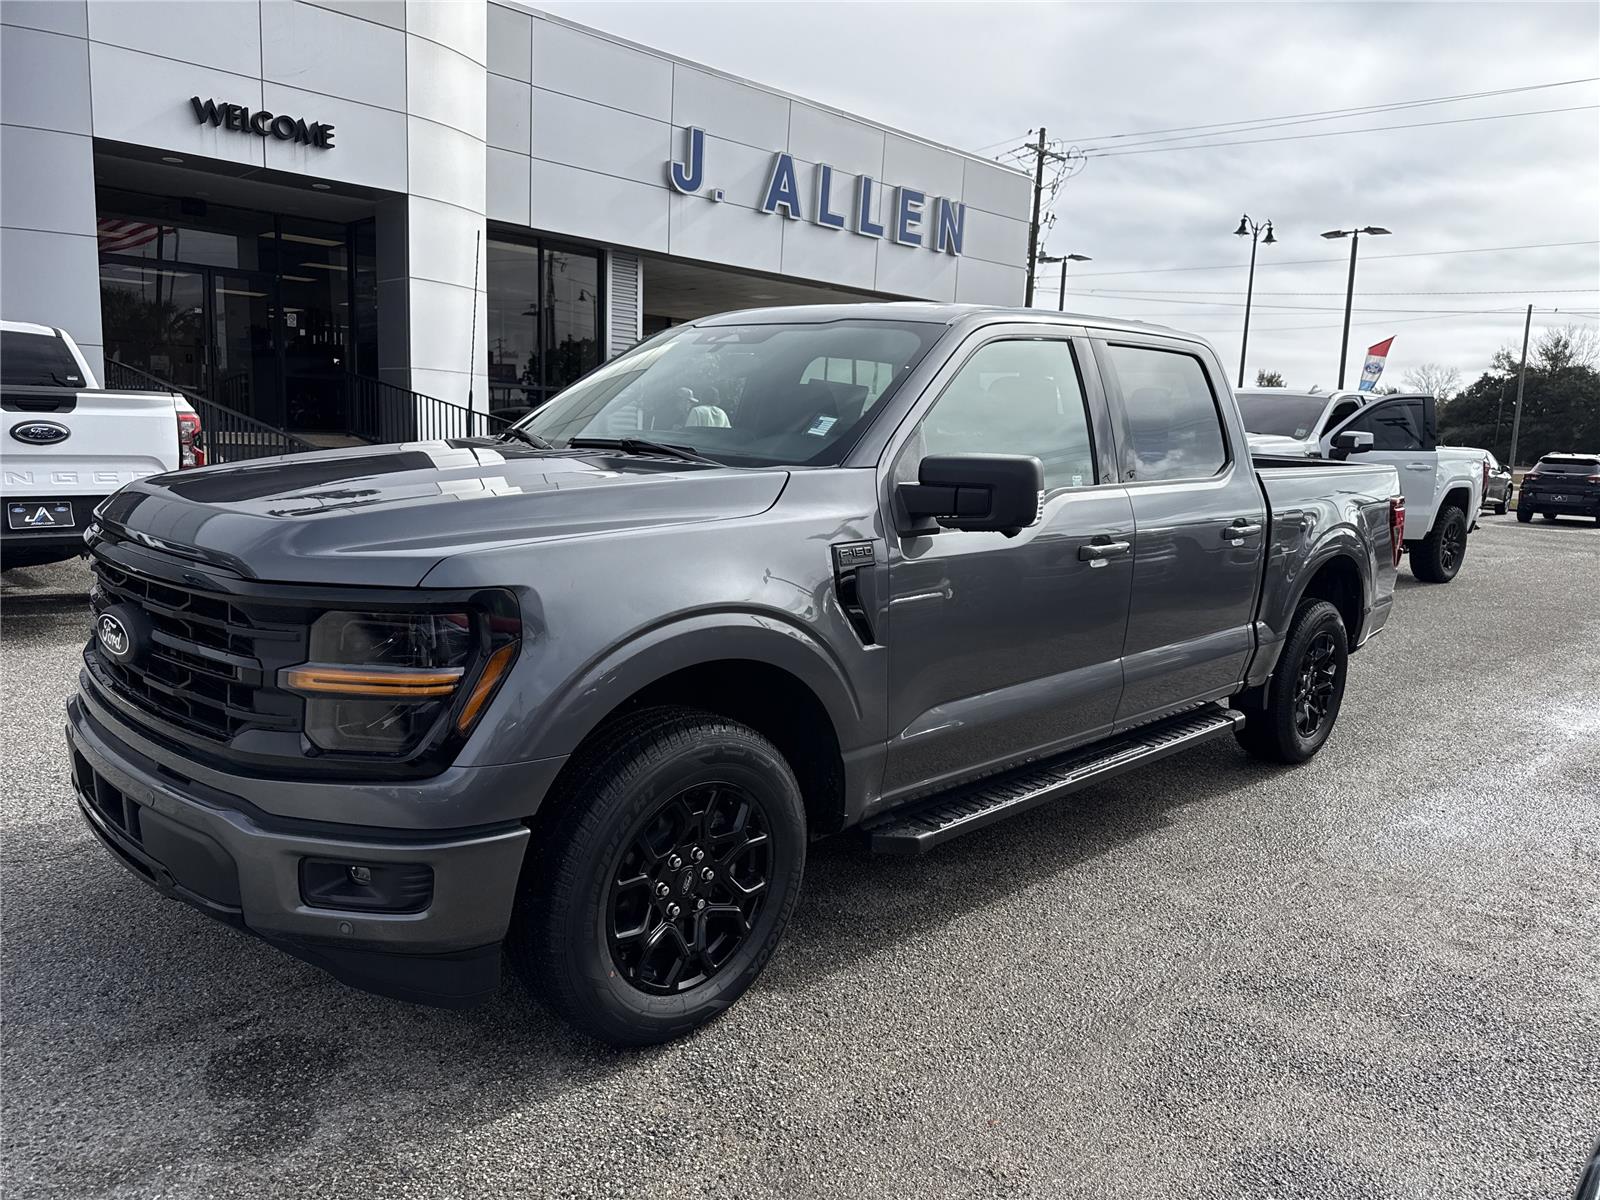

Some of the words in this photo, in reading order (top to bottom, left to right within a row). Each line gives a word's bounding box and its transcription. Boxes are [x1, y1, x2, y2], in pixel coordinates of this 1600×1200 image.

[190, 96, 335, 149] WELCOME
[667, 125, 726, 202] J.
[759, 151, 967, 256] ALLEN
[840, 546, 873, 559] F-150
[101, 617, 123, 651] Ford
